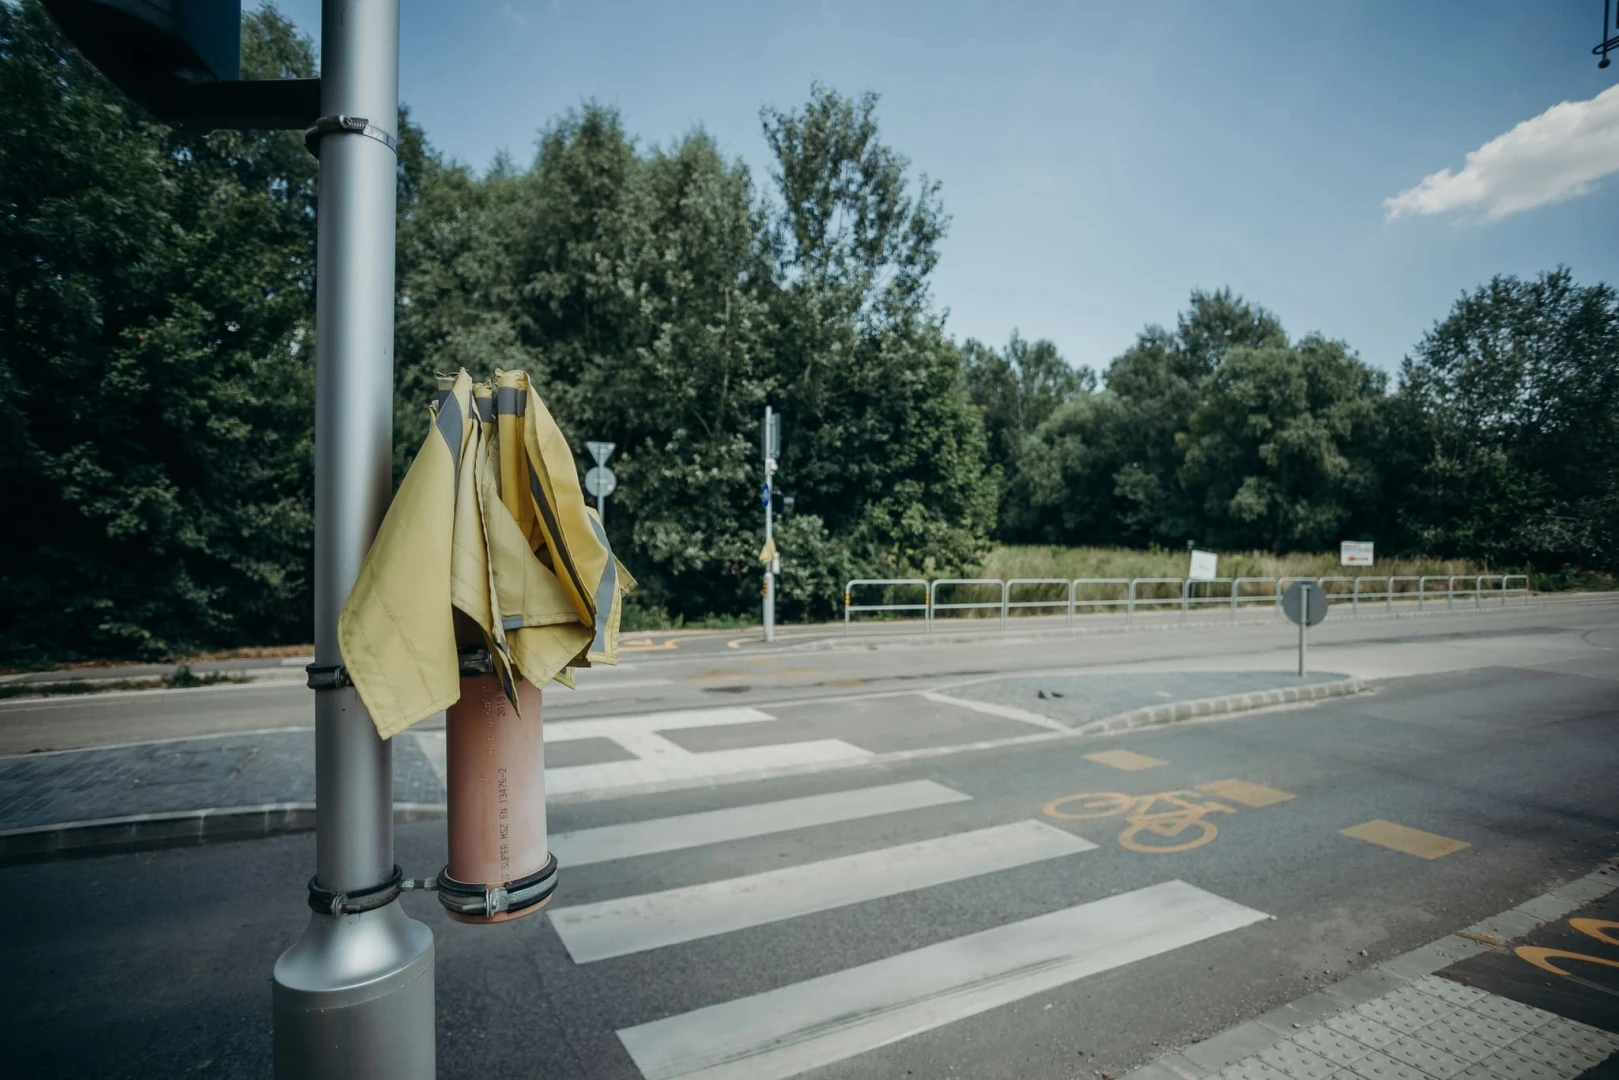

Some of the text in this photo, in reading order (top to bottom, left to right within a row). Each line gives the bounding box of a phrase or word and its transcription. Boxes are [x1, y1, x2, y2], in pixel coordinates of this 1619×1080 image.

[496, 696, 506, 717] 2019
[498, 767, 508, 804] 13476-2
[499, 807, 508, 820] EN
[499, 823, 509, 840] MSZ
[499, 843, 509, 870] SUPER
